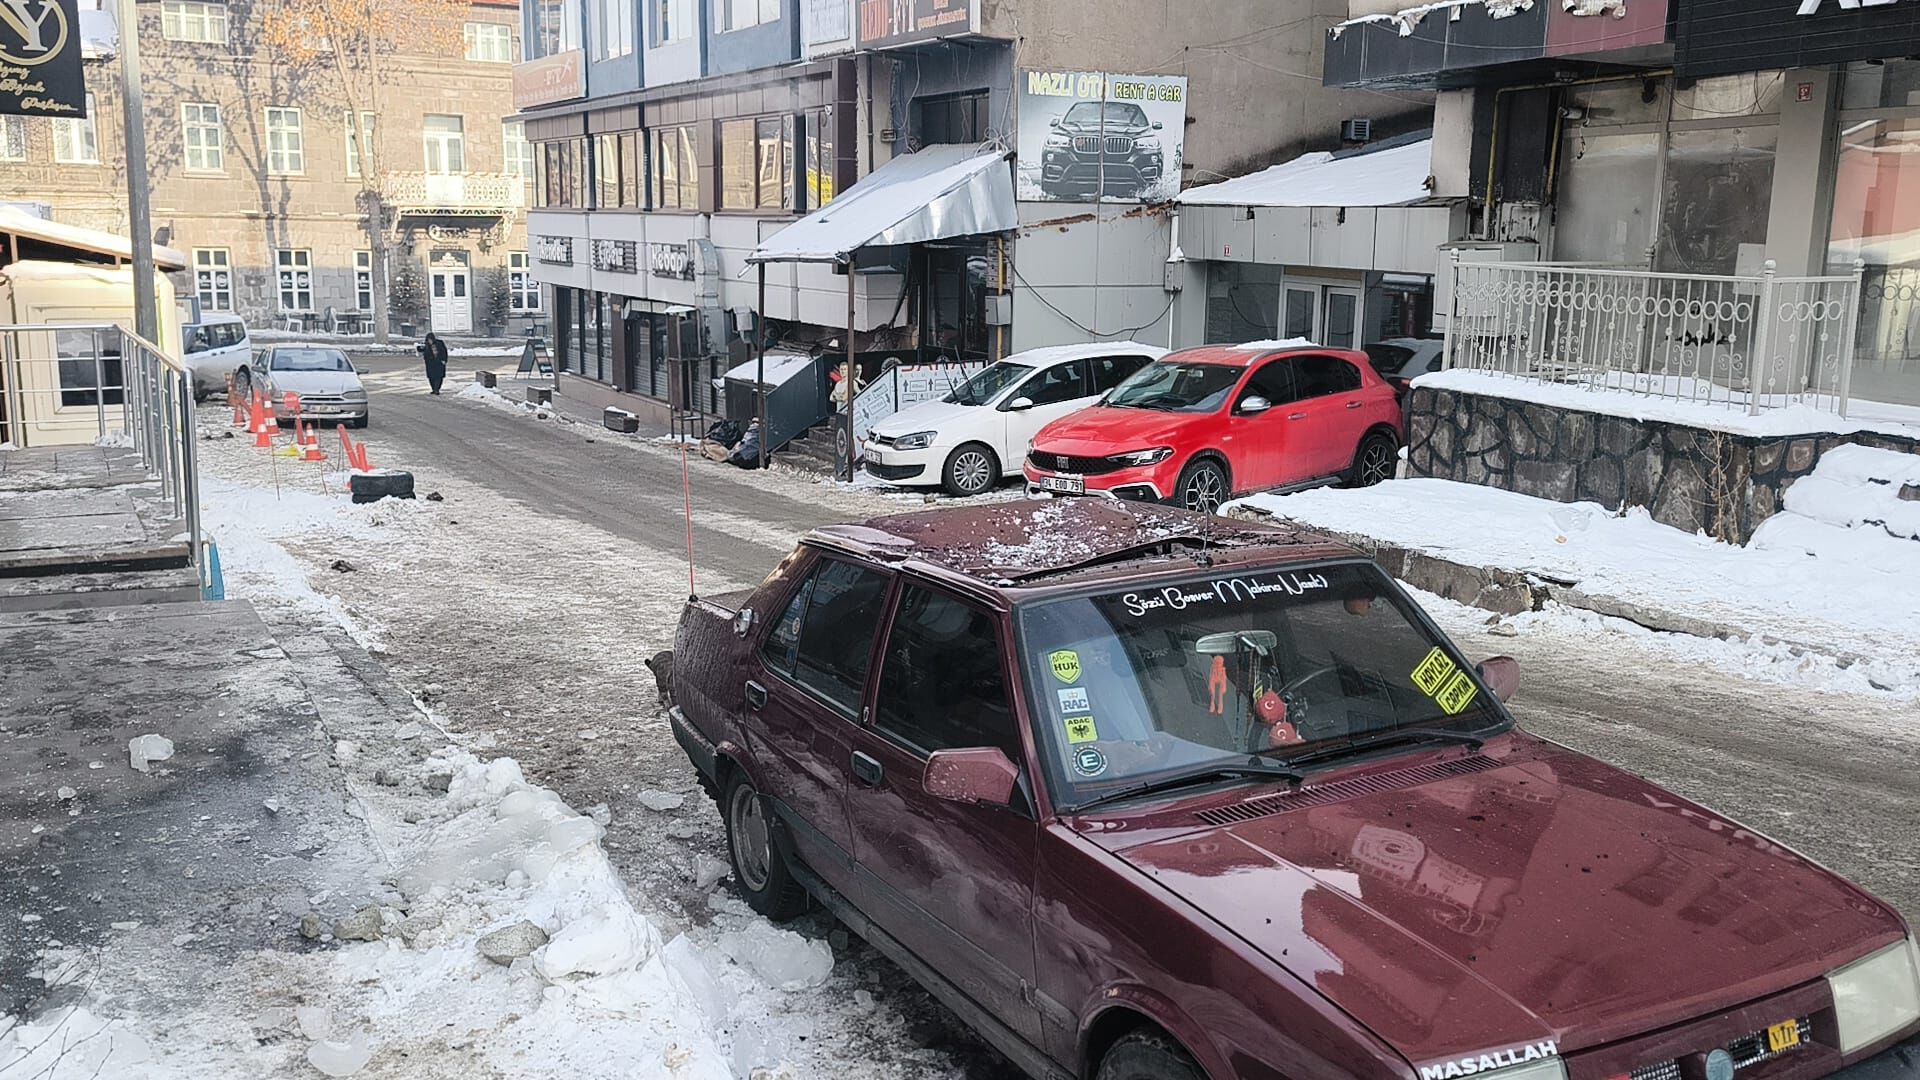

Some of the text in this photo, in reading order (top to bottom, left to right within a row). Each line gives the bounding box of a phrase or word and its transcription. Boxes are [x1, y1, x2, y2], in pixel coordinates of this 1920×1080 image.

[1028, 72, 1182, 102] NAZLI OTO RENT A CAR
[1070, 481, 1083, 492] 791
[1211, 578, 1283, 604] Makina
[1053, 662, 1079, 672] HUK
[1062, 698, 1088, 711] RAC
[1067, 717, 1091, 725] ADAC
[1081, 753, 1099, 768] E
[1420, 1040, 1558, 1080] MASALLAH
